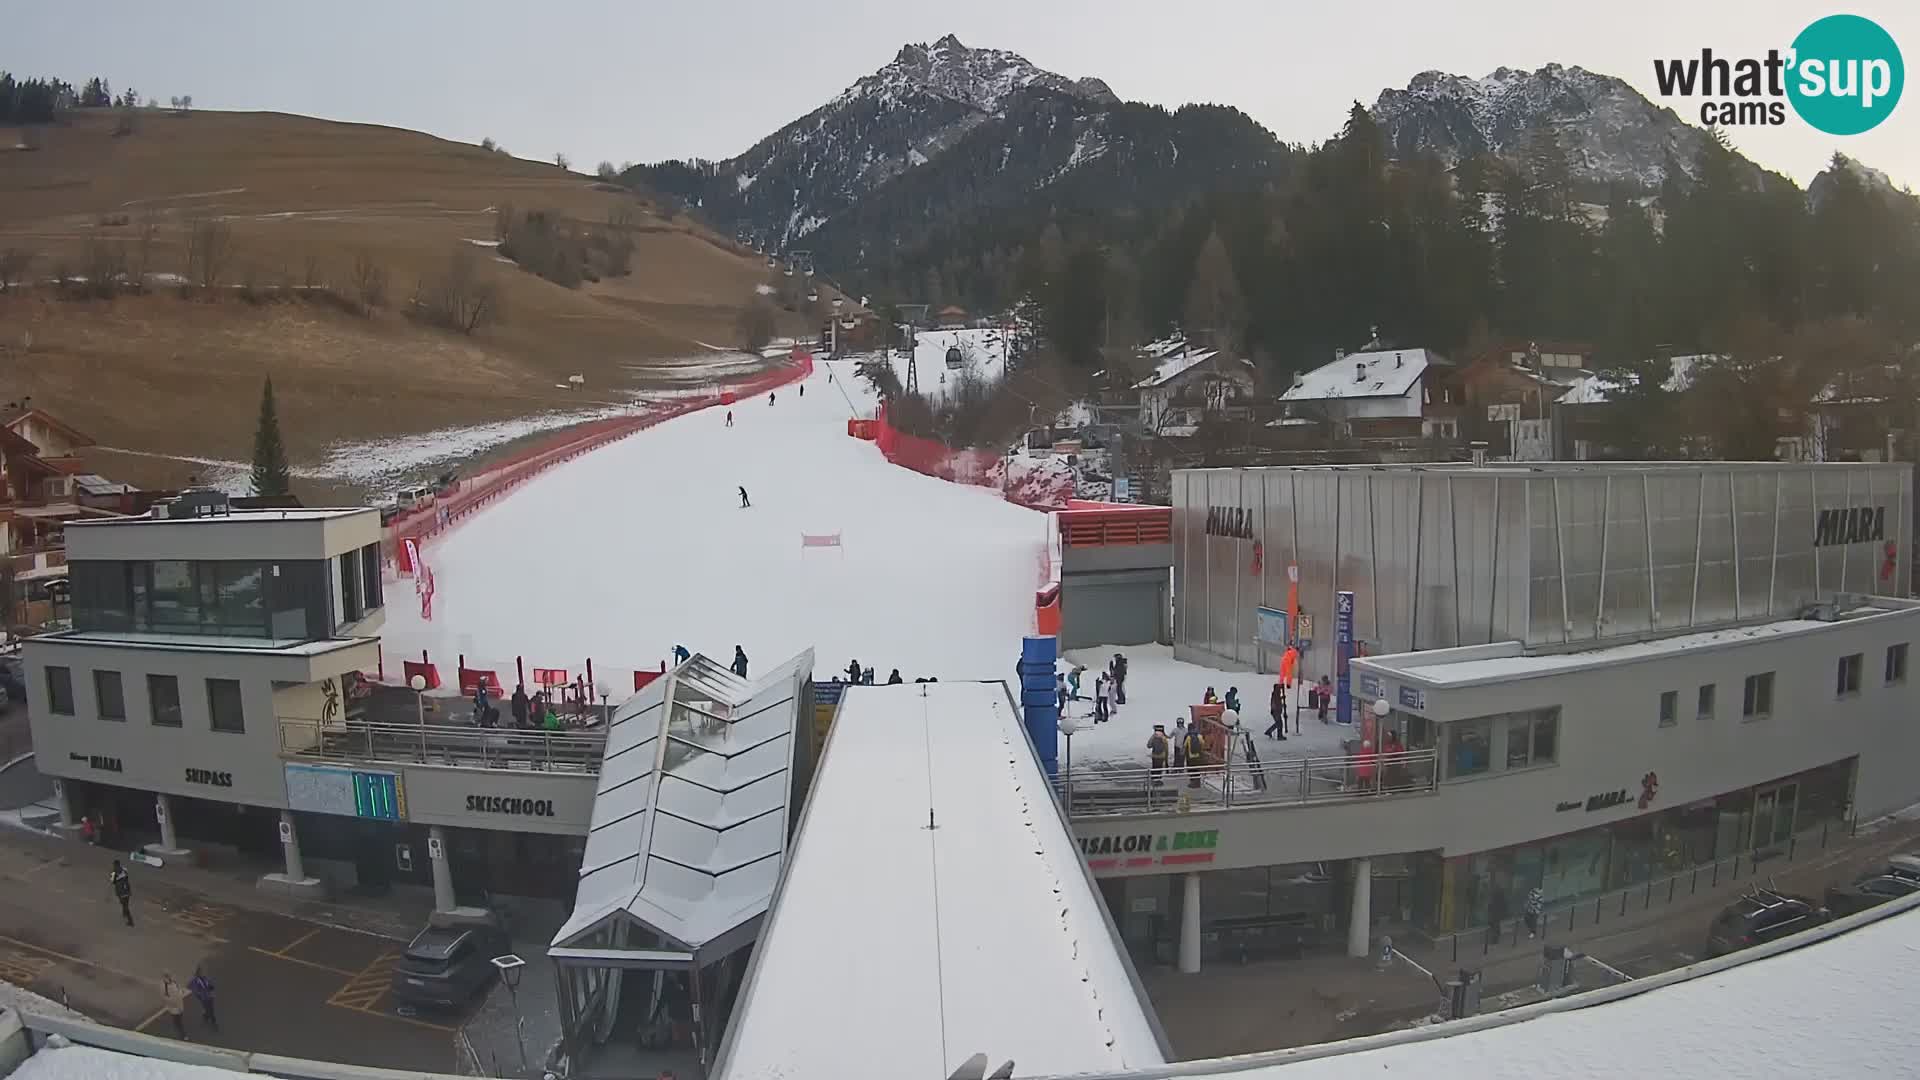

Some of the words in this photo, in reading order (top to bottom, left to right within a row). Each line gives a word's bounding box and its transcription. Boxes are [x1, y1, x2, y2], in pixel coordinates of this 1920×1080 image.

[1206, 505, 1253, 540] MIARA
[1814, 506, 1885, 547] MIARA
[185, 768, 233, 787] SKIPASS
[466, 795, 555, 817] SKISCHOOL
